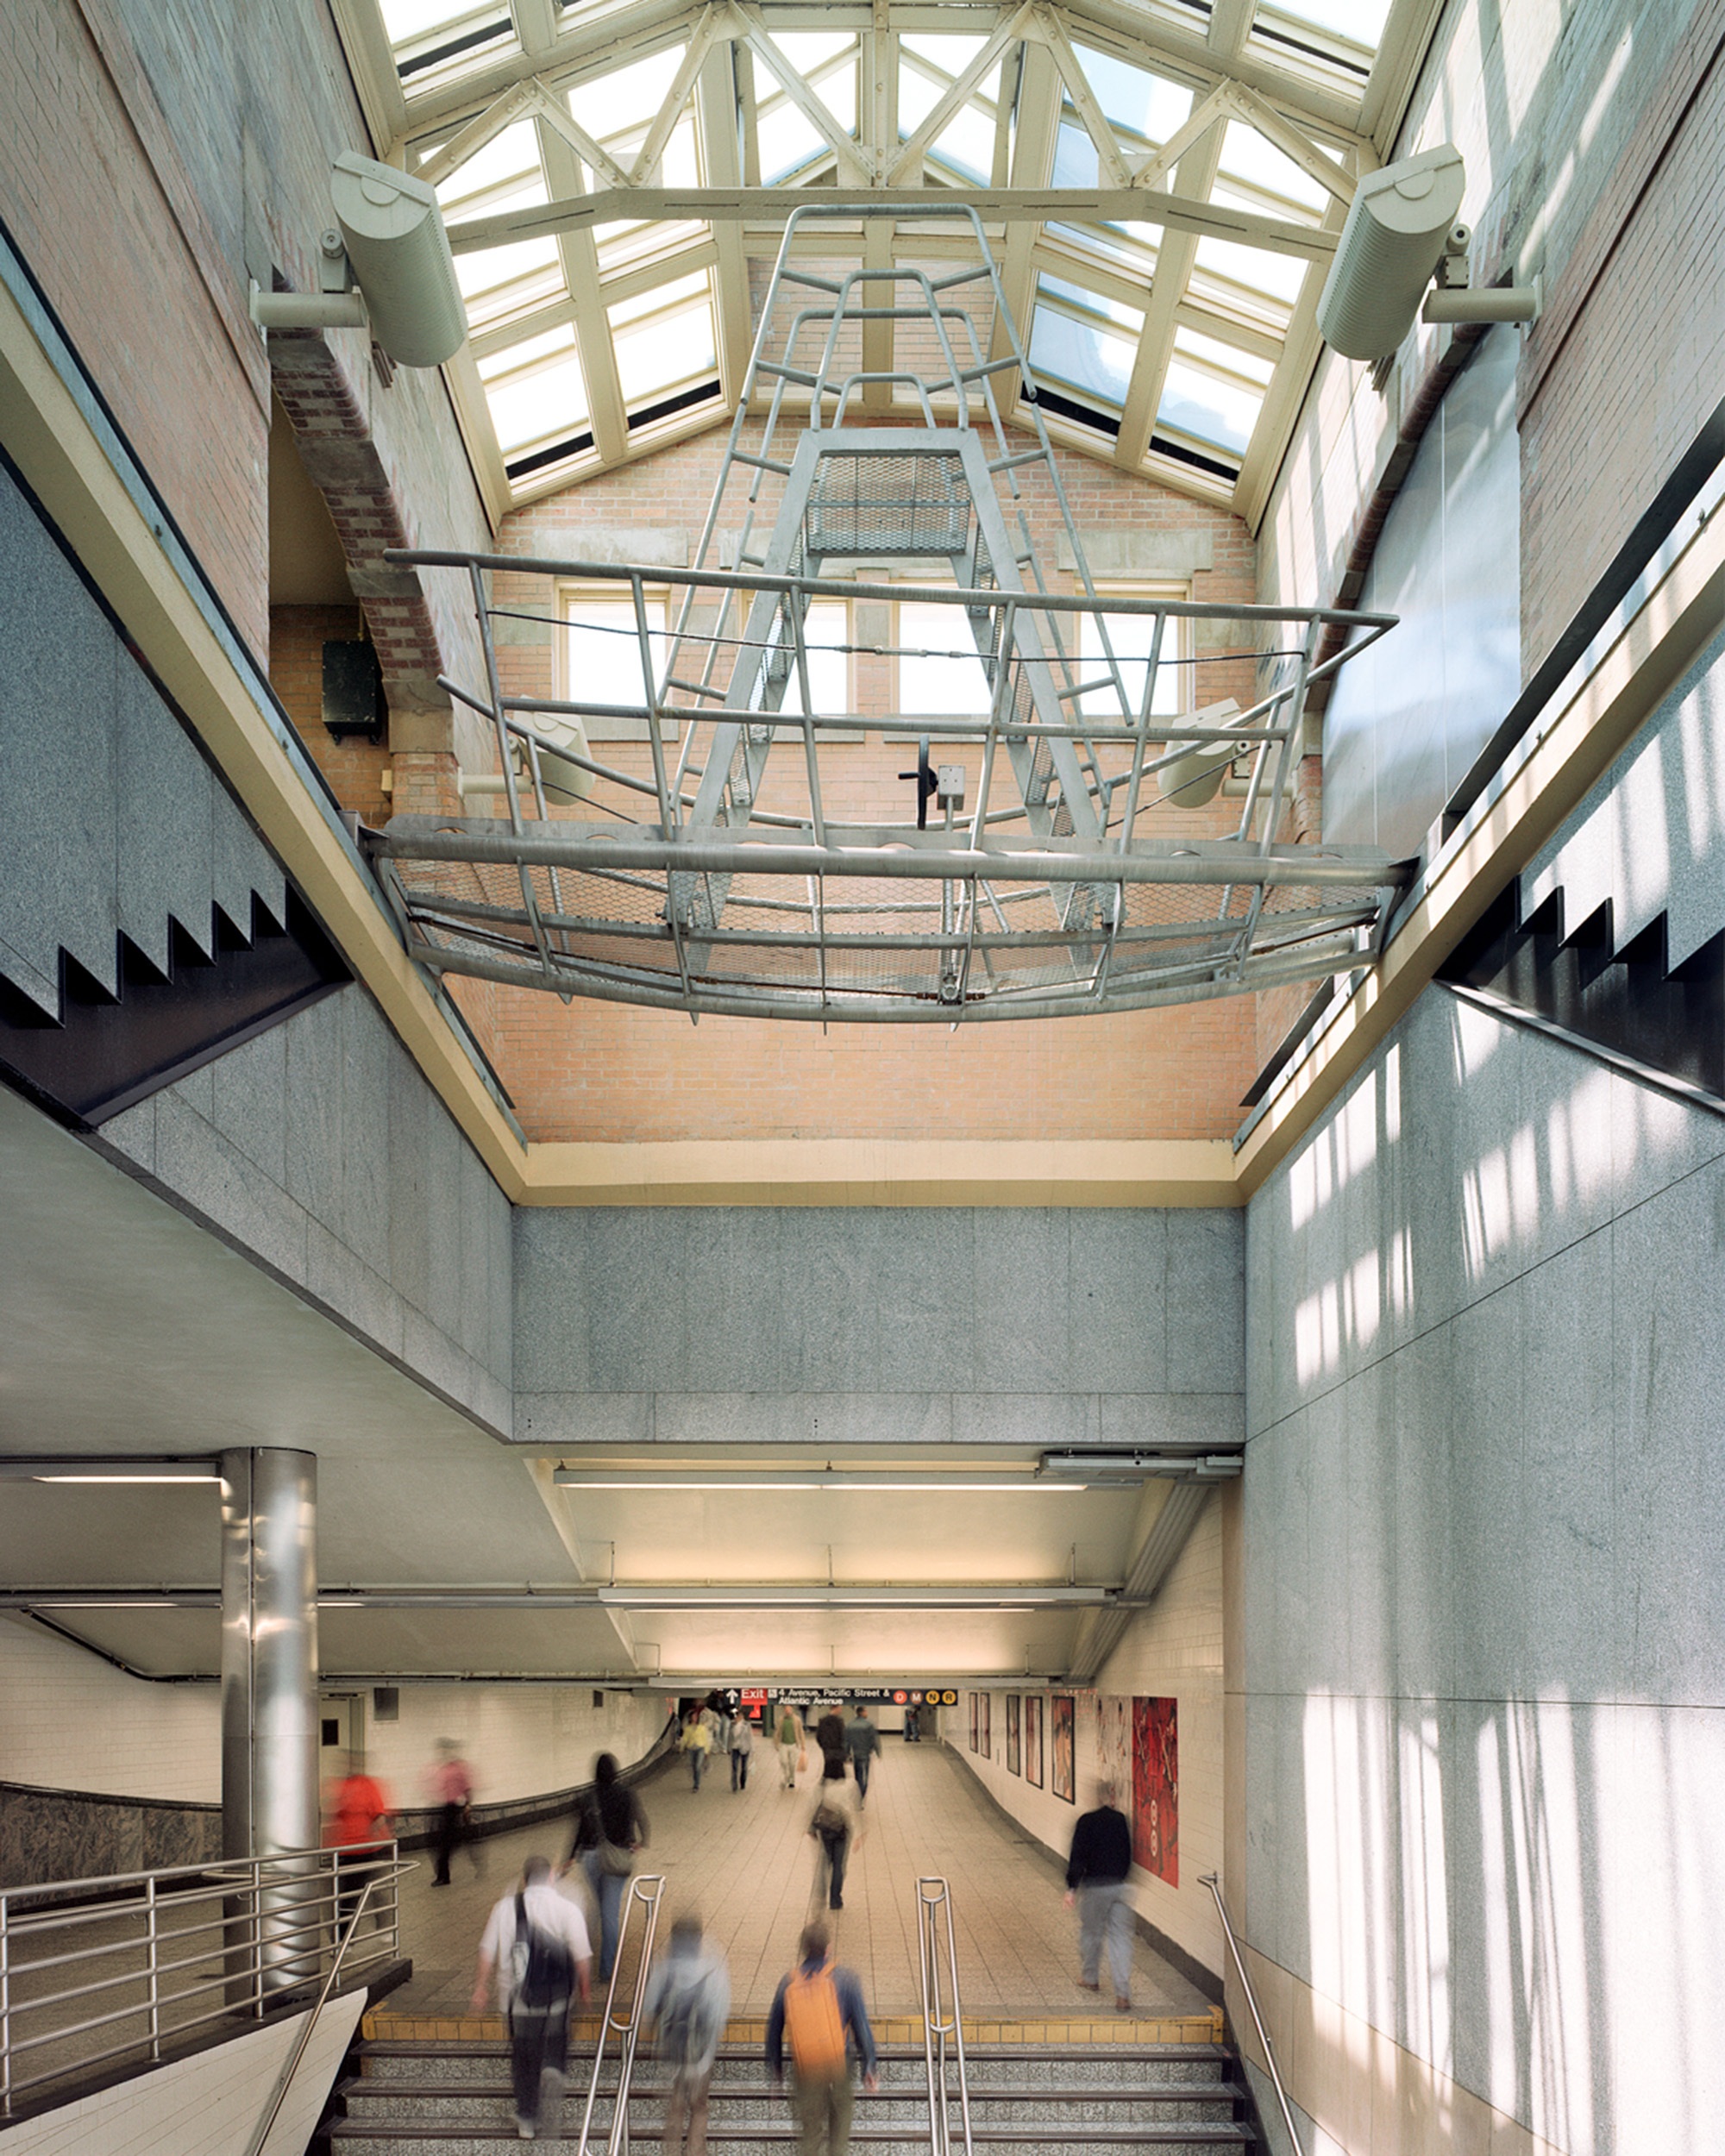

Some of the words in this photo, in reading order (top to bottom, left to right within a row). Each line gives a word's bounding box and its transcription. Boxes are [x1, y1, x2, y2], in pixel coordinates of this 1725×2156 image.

[742, 1689, 764, 1699] Exit
[779, 1689, 785, 1697] 4
[788, 1689, 820, 1697] Avenue,
[824, 1689, 851, 1697] Pacific
[854, 1689, 880, 1697] Street
[883, 1689, 890, 1697] &
[779, 1696, 810, 1705] Atlantic
